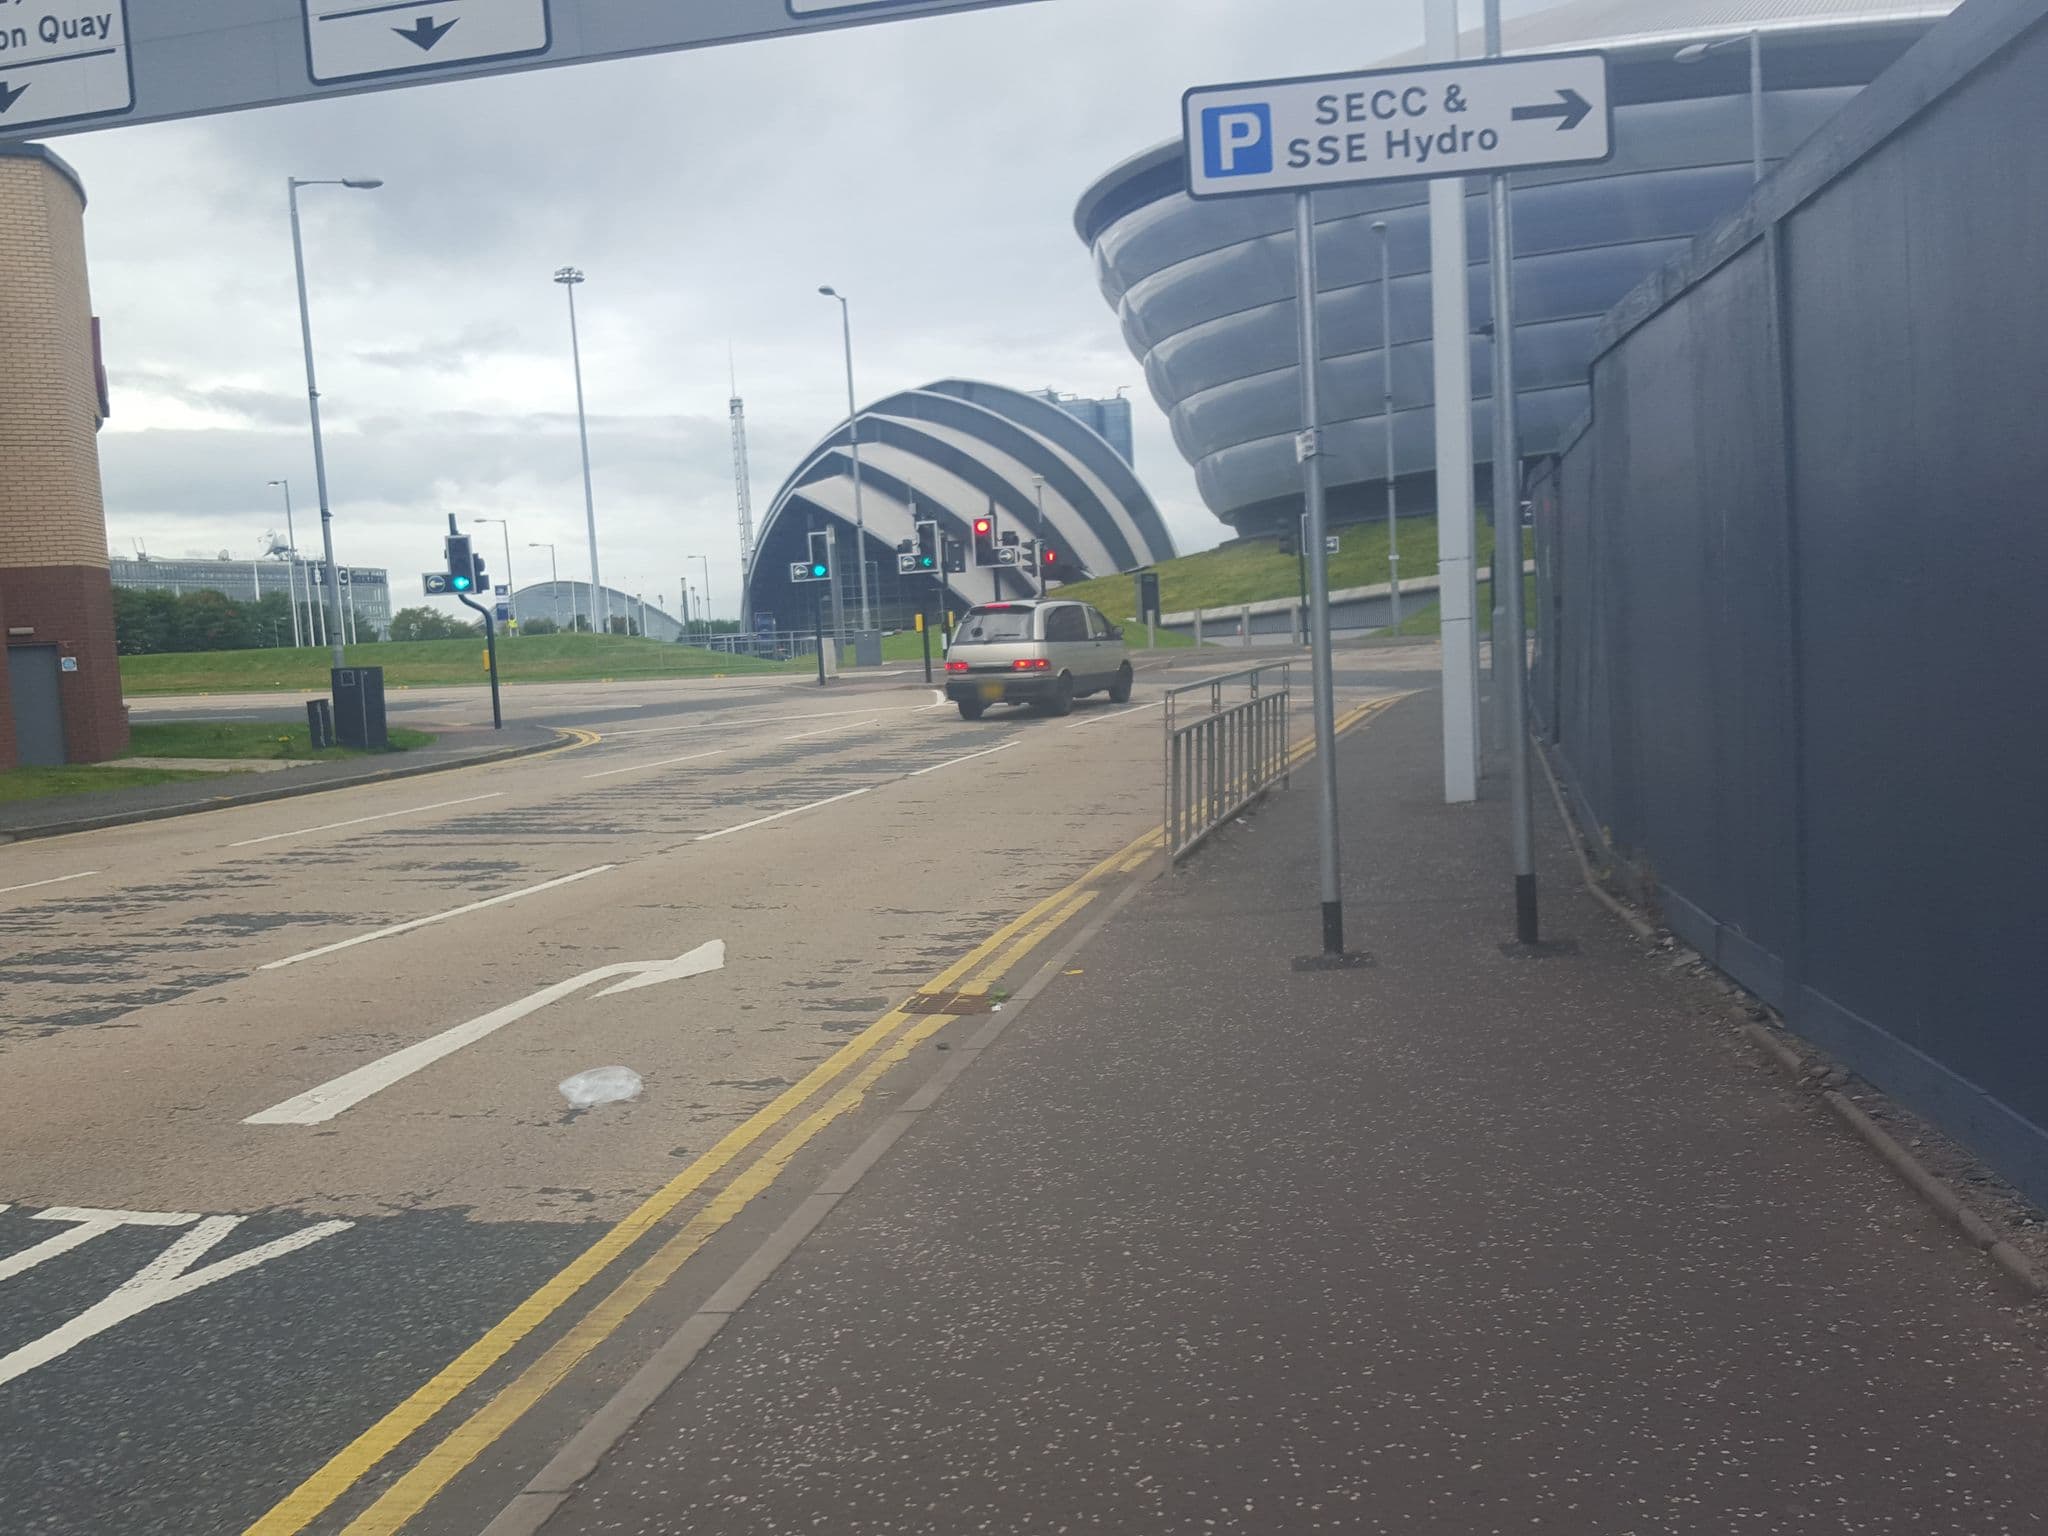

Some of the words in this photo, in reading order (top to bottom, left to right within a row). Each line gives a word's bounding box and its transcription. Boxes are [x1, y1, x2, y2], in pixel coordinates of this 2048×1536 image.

[38, 13, 112, 44] Quay
[1315, 87, 1427, 125] SECC
[1444, 84, 1468, 112] &
[1219, 112, 1262, 171] P
[1287, 133, 1368, 168] SSE
[1386, 124, 1498, 162] Hydro
